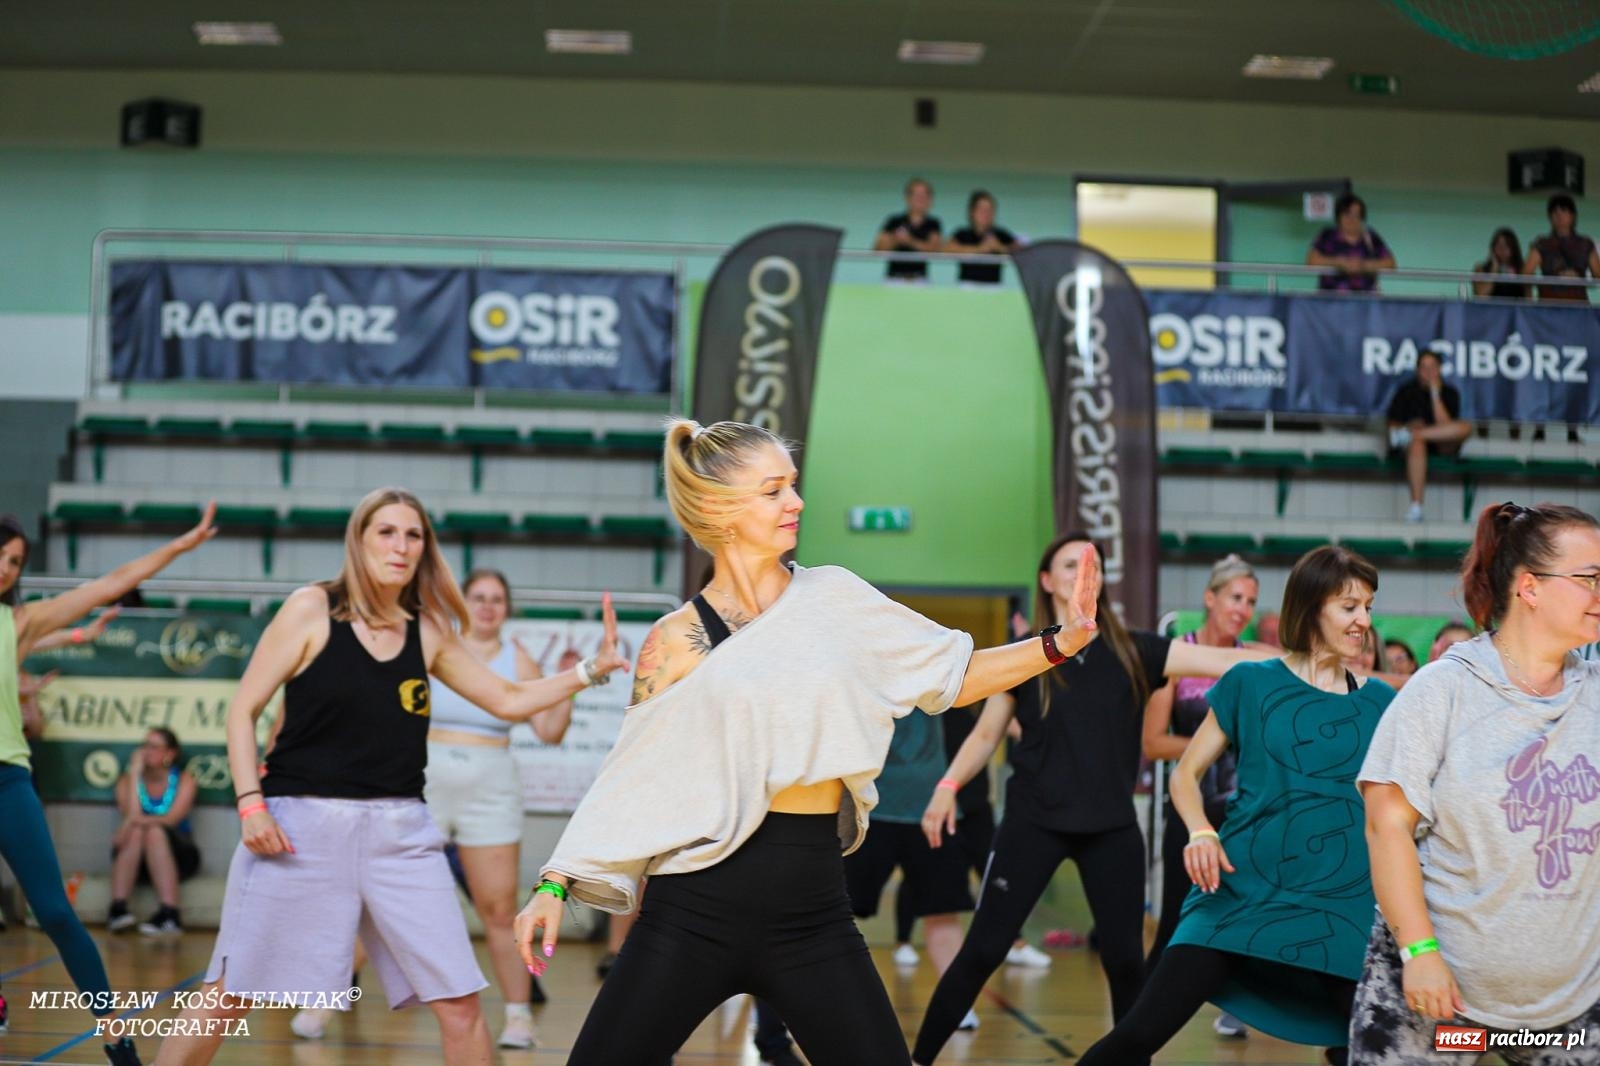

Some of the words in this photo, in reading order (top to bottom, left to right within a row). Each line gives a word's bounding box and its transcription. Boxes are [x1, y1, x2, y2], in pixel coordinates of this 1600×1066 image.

[160, 292, 398, 343] RACIBÓRZ
[1362, 332, 1588, 383] RACIBÓRZ
[42, 692, 178, 727] ABINET
